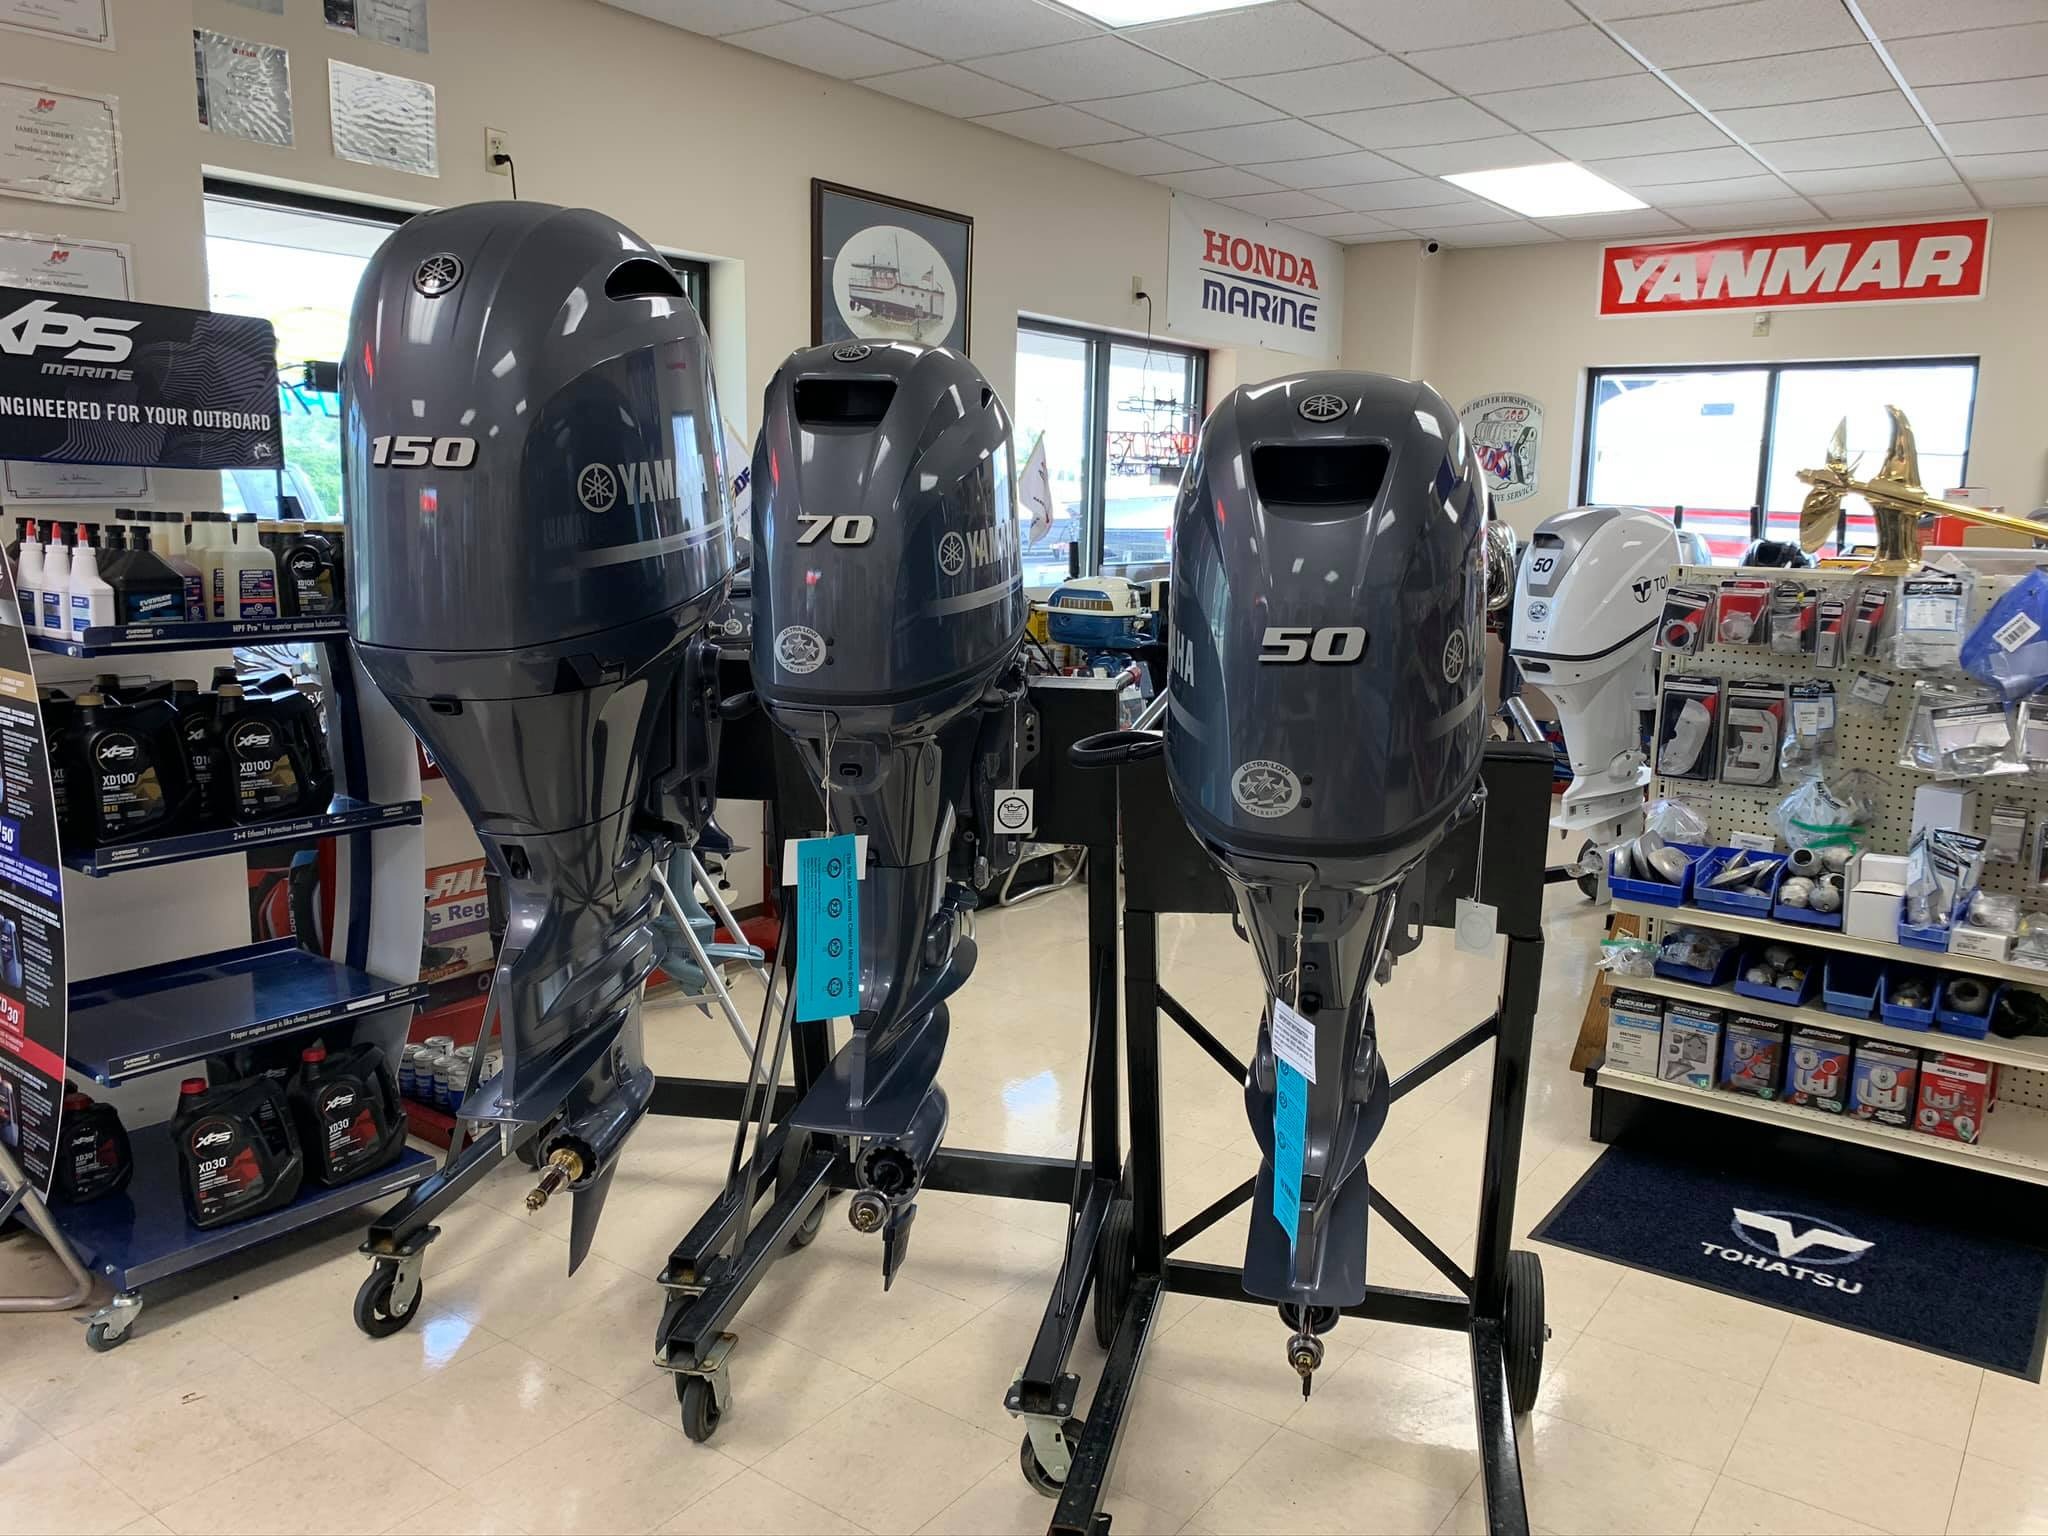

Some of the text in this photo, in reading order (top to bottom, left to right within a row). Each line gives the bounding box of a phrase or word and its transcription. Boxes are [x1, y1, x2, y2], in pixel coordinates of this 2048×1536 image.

[1203, 228, 1319, 290] HONDA
[1613, 235, 1973, 304] YANMAR
[1202, 278, 1317, 332] MARINE
[41, 362, 134, 381] MARINE
[0, 396, 271, 431] NGINEERED FOR YOUR OUTBOARD
[371, 435, 477, 468] 150
[617, 453, 709, 505] YAMA
[796, 514, 876, 544] 70
[1533, 558, 1554, 573] 50
[233, 624, 246, 633] HPF
[262, 622, 271, 631] for
[271, 622, 293, 632] superior
[1257, 626, 1367, 663] 50
[237, 733, 273, 747] XPS
[99, 745, 137, 760] XPS
[240, 760, 271, 773] XD100
[102, 772, 136, 787] XD100
[247, 827, 267, 839] Ethanol
[267, 824, 292, 835] Protection
[292, 821, 313, 831] Formula
[230, 1030, 249, 1041] Proper
[248, 1027, 266, 1037] engine
[293, 1014, 308, 1026] cheap
[1737, 1016, 1779, 1029] MERCURY
[1802, 1028, 1844, 1040] MERCURY
[325, 1093, 356, 1111] XPS
[328, 1118, 349, 1135] XD30
[194, 1131, 232, 1149] XPS
[198, 1157, 227, 1174] XD30
[1701, 1241, 1863, 1294] TOHATSU
